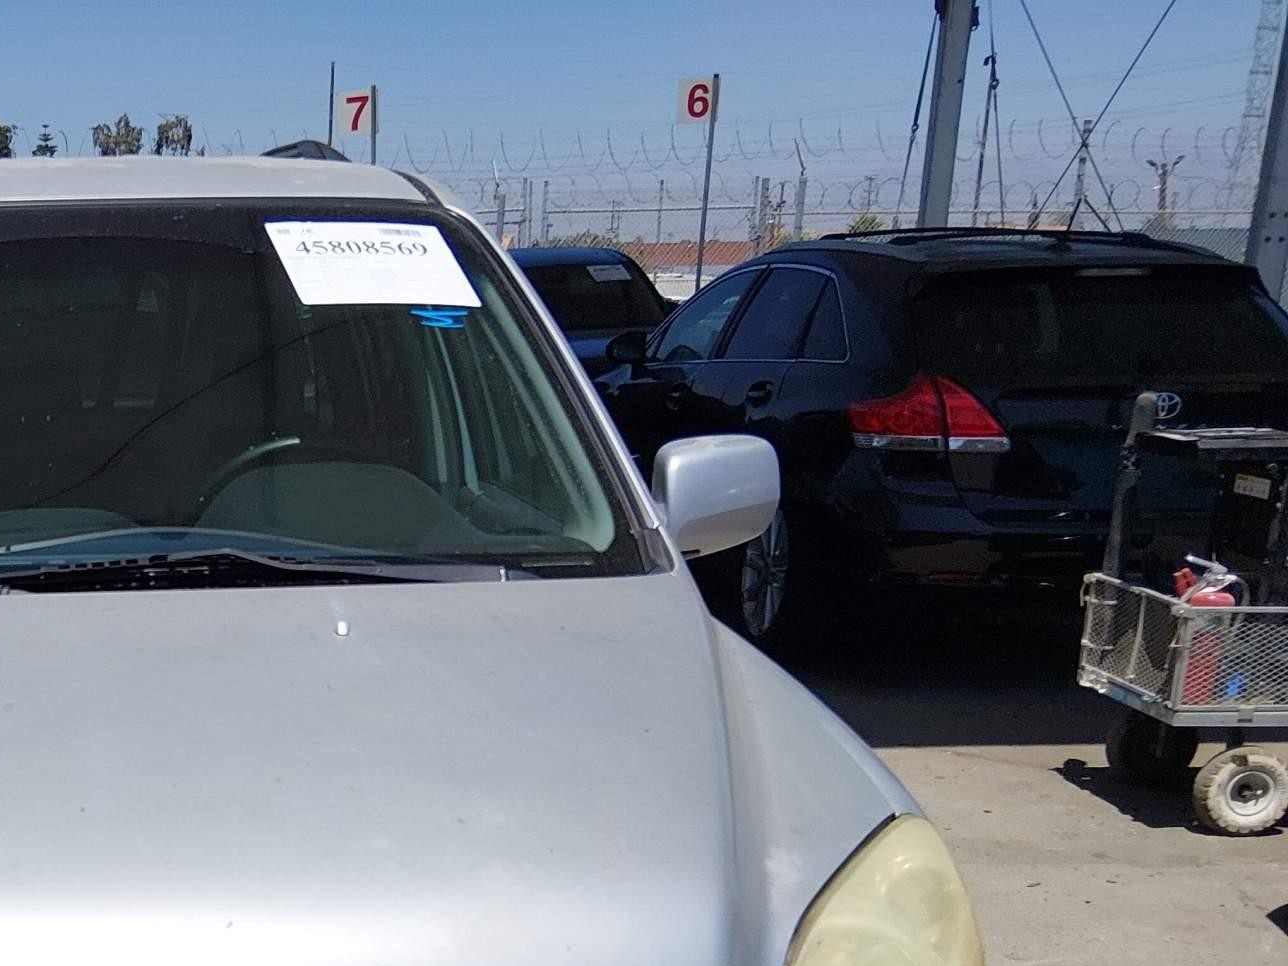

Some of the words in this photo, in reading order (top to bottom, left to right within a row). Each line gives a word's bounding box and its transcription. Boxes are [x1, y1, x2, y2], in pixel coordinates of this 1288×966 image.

[346, 96, 369, 131] 7
[688, 84, 709, 118] 6
[295, 240, 428, 257] 45808569
